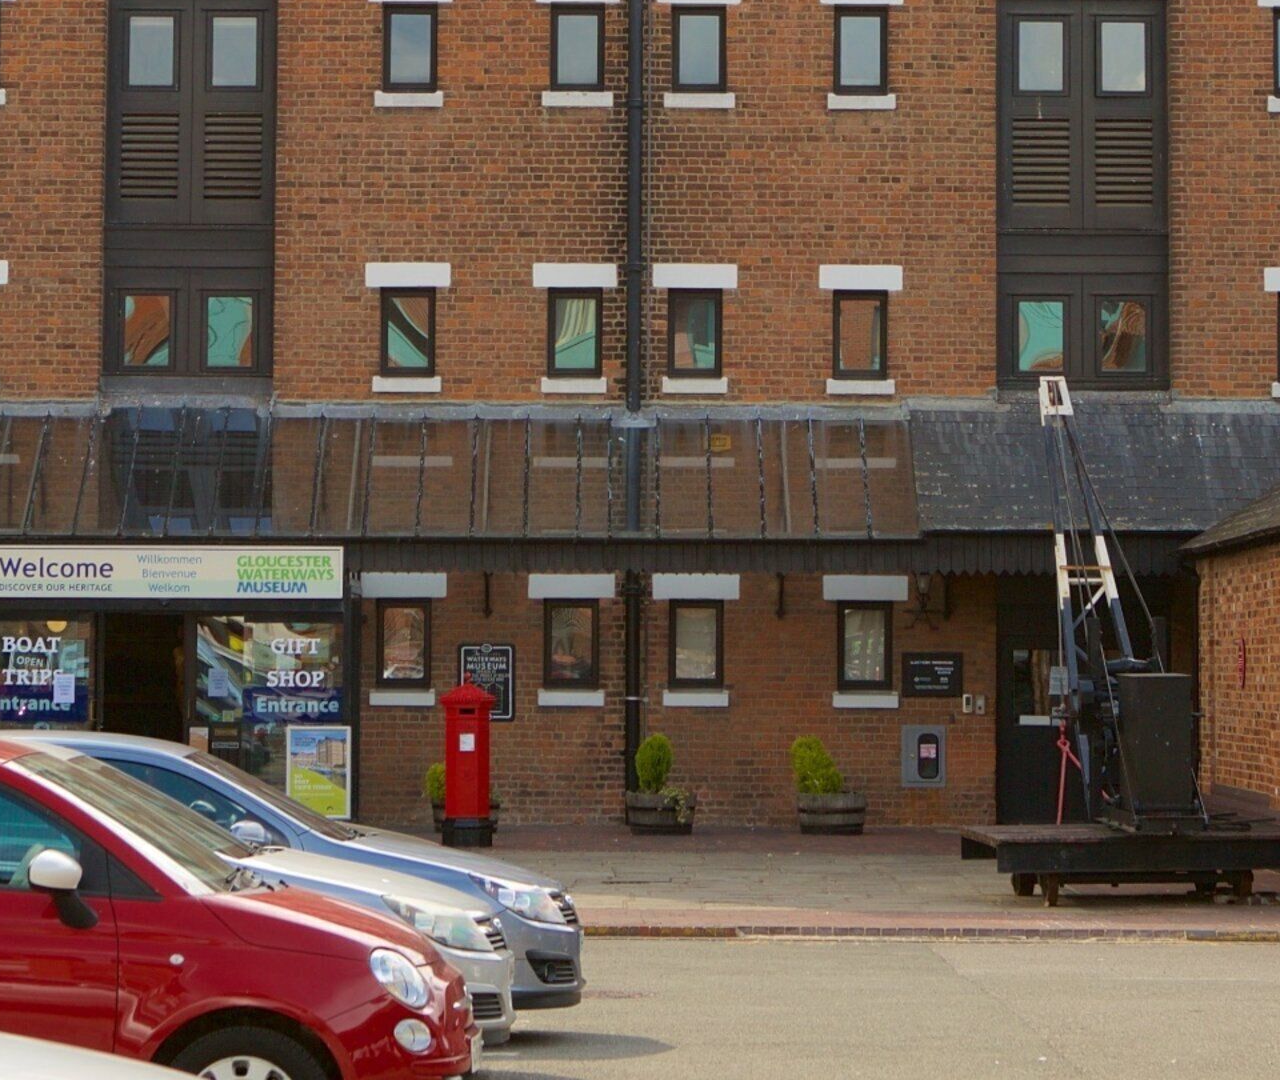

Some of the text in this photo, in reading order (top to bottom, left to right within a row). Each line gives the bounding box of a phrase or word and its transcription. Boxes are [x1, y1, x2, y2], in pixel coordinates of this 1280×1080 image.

[136, 553, 203, 565] Willkommen
[236, 555, 332, 568] GLOUCESTER
[141, 568, 198, 579] Bienvenue
[236, 568, 335, 581] WATERWAYS
[46, 583, 65, 592] OUR
[70, 583, 113, 592] HERITAGE
[148, 581, 191, 593] Welkom
[236, 581, 308, 594] MUSEUM
[1, 636, 62, 653] BOAT
[270, 638, 321, 655] GIFT
[16, 655, 44, 667] OPEN
[466, 662, 507, 670] MUSEUM
[265, 670, 325, 688] SHOP
[255, 697, 340, 713] Entrance
